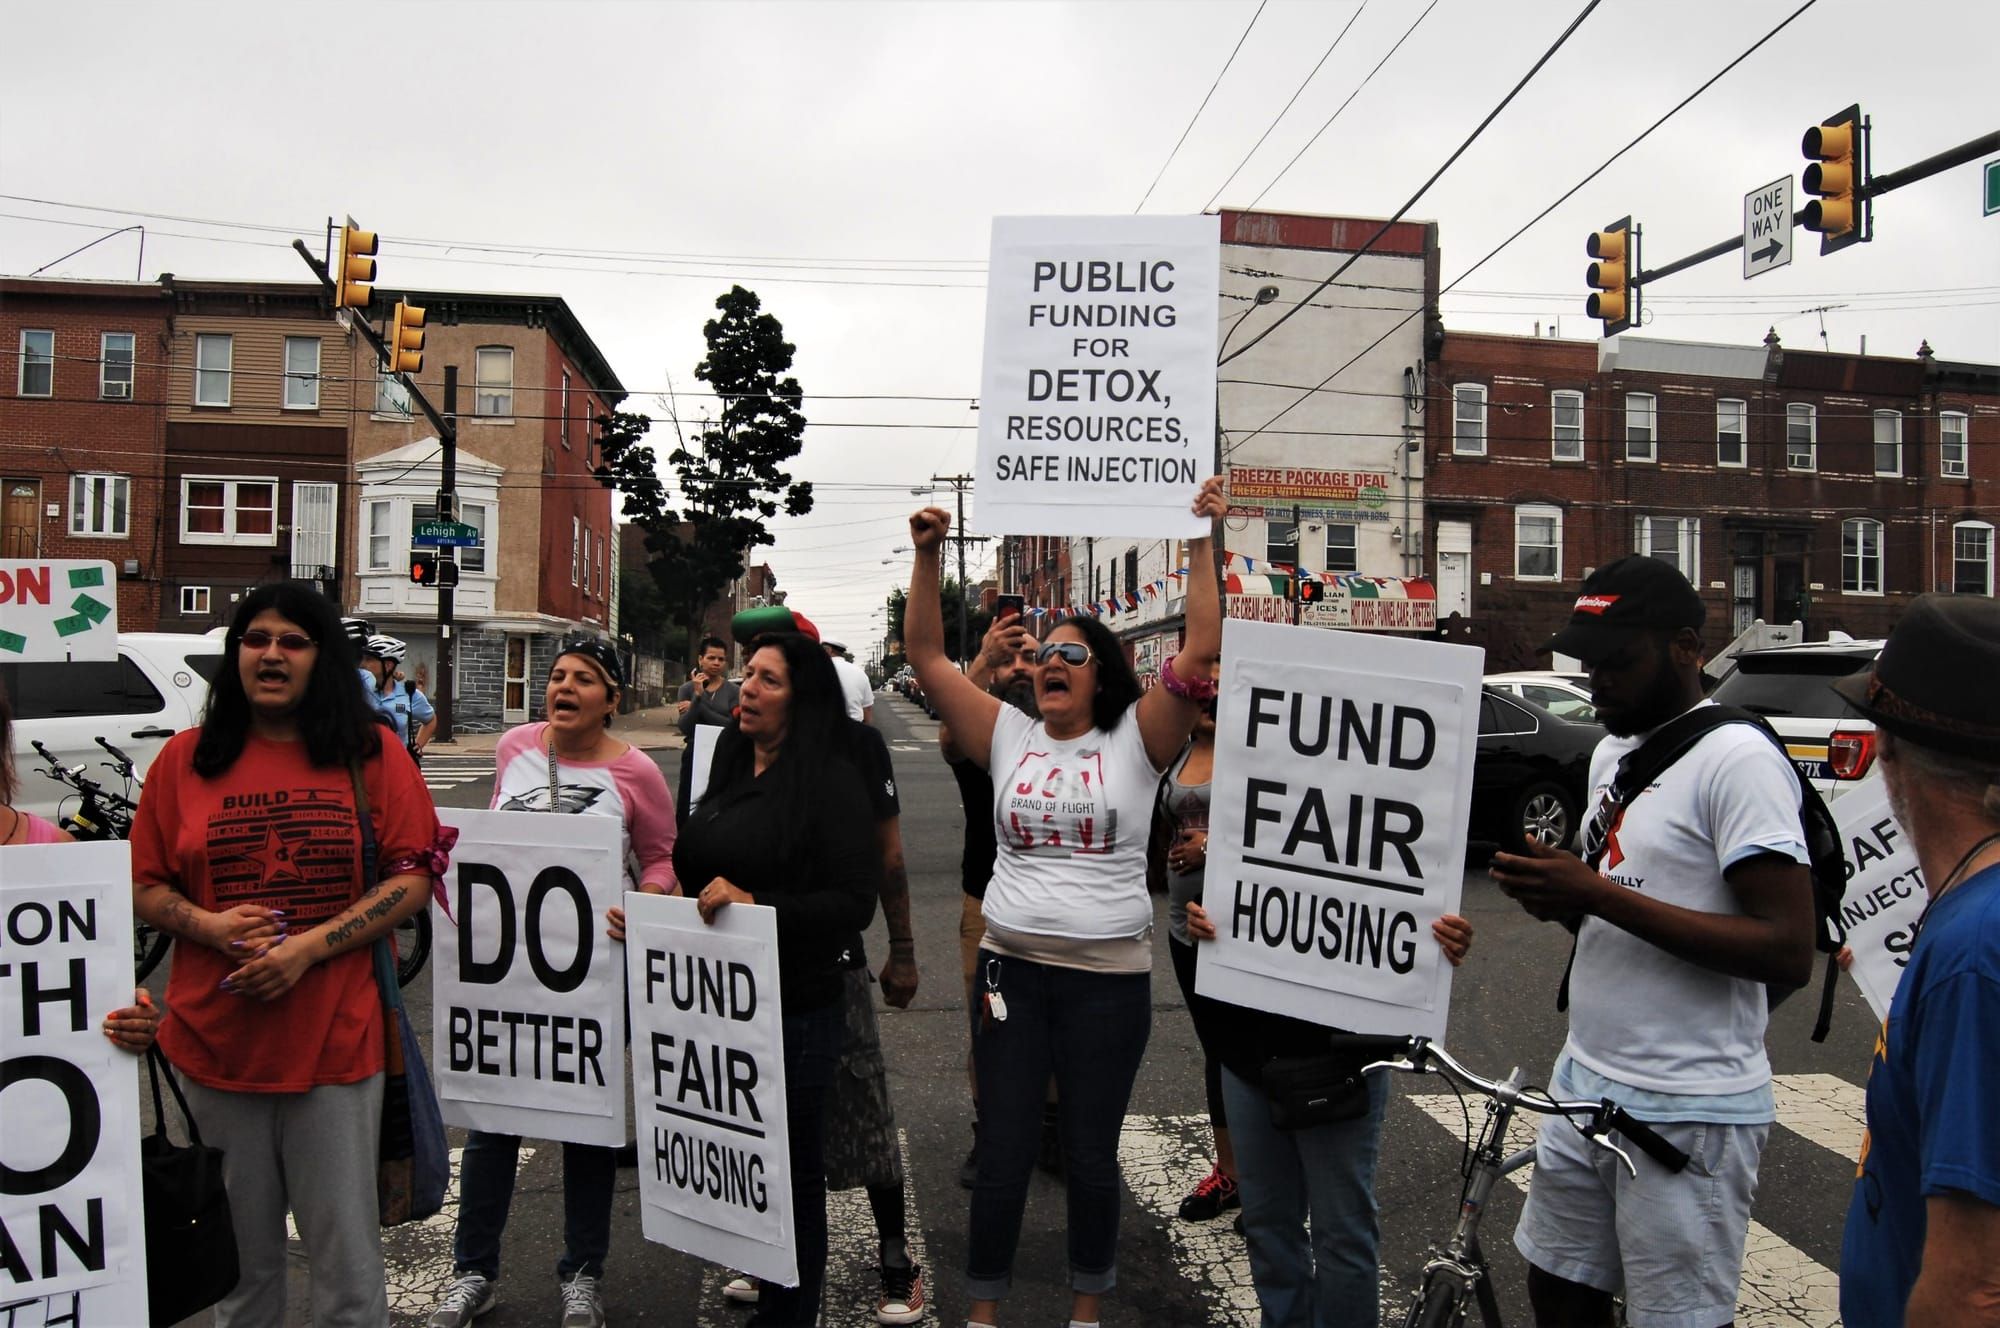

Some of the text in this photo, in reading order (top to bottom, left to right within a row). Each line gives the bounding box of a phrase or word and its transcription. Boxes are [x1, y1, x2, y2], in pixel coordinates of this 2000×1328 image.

[1753, 187, 1783, 216] ONE
[1752, 210, 1783, 240] WAY
[1033, 261, 1175, 293] PUBLIC
[1029, 304, 1176, 328] FUNDING
[1073, 338, 1129, 358] FOR
[1028, 369, 1171, 409] DETOX,
[1007, 415, 1189, 447] RESOURCES,
[996, 455, 1196, 484] SAFE INJECTION
[1230, 468, 1389, 489] FREEZE PACKAGE DEAL
[1231, 486, 1357, 498] FREEZER WITH WARRANTY
[420, 526, 455, 537] Lehigh
[1351, 600, 1360, 626] HOT
[1361, 601, 1375, 626] DOGS
[1378, 601, 1396, 627] FUNNEL
[1397, 602, 1409, 627] CAKE
[1246, 686, 1436, 771] FUND
[223, 791, 289, 810] BUILD
[1010, 798, 1095, 815] BRAND OF FLIGHT
[1242, 777, 1424, 879] FAIR
[0, 898, 97, 947] ON
[456, 862, 595, 994] DO
[1232, 879, 1418, 975] HOUSING
[0, 957, 89, 1037] H
[646, 948, 757, 1022] FUND
[448, 1005, 606, 1087] BETTER
[650, 1031, 764, 1124] FAIR
[654, 1126, 769, 1214] HOUSING
